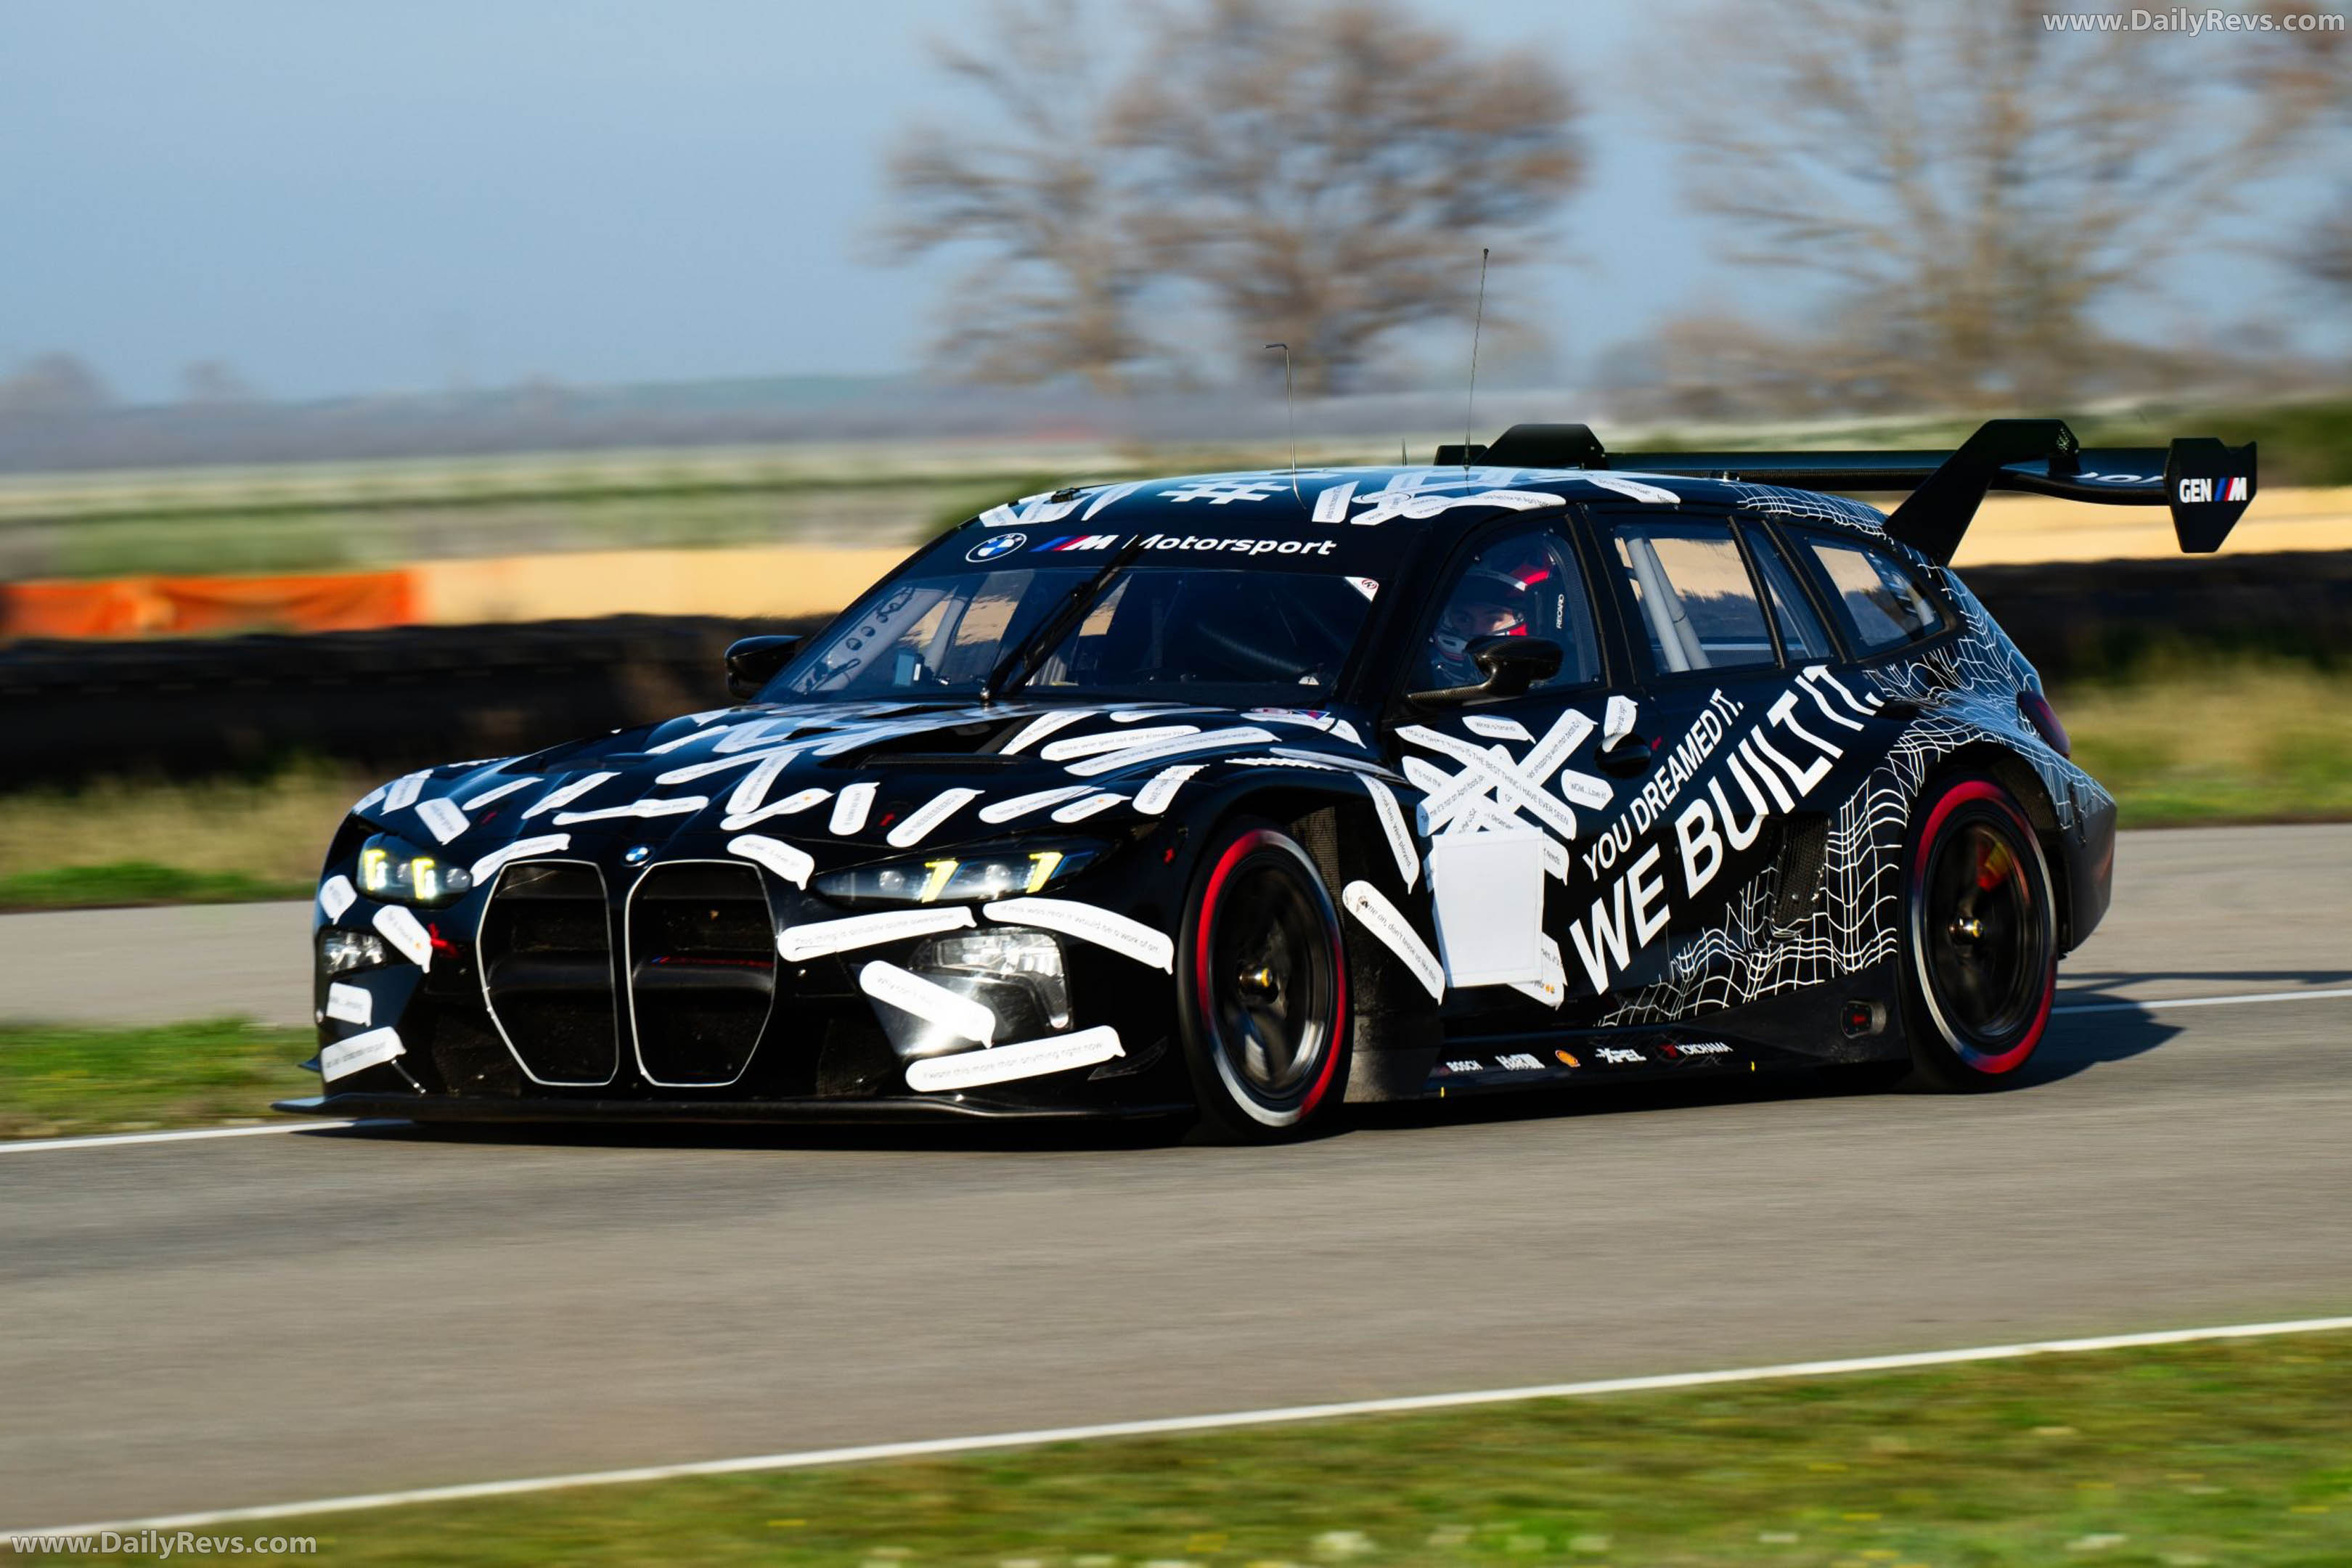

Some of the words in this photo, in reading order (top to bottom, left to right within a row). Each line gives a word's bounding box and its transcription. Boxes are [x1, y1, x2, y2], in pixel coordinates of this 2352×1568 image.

[2179, 478, 2212, 503] GEN
[1556, 594, 1564, 629] RECARO
[1583, 814, 1633, 882] YOU
[1630, 709, 1723, 836] DREAMED
[1710, 688, 1744, 725] IT.
[1569, 843, 1670, 995] WE
[1675, 690, 1844, 899] BUILT
[1794, 664, 1885, 732] IT.
[1387, 922, 1403, 940] don't
[1675, 1042, 1733, 1055] YOKOHAMA
